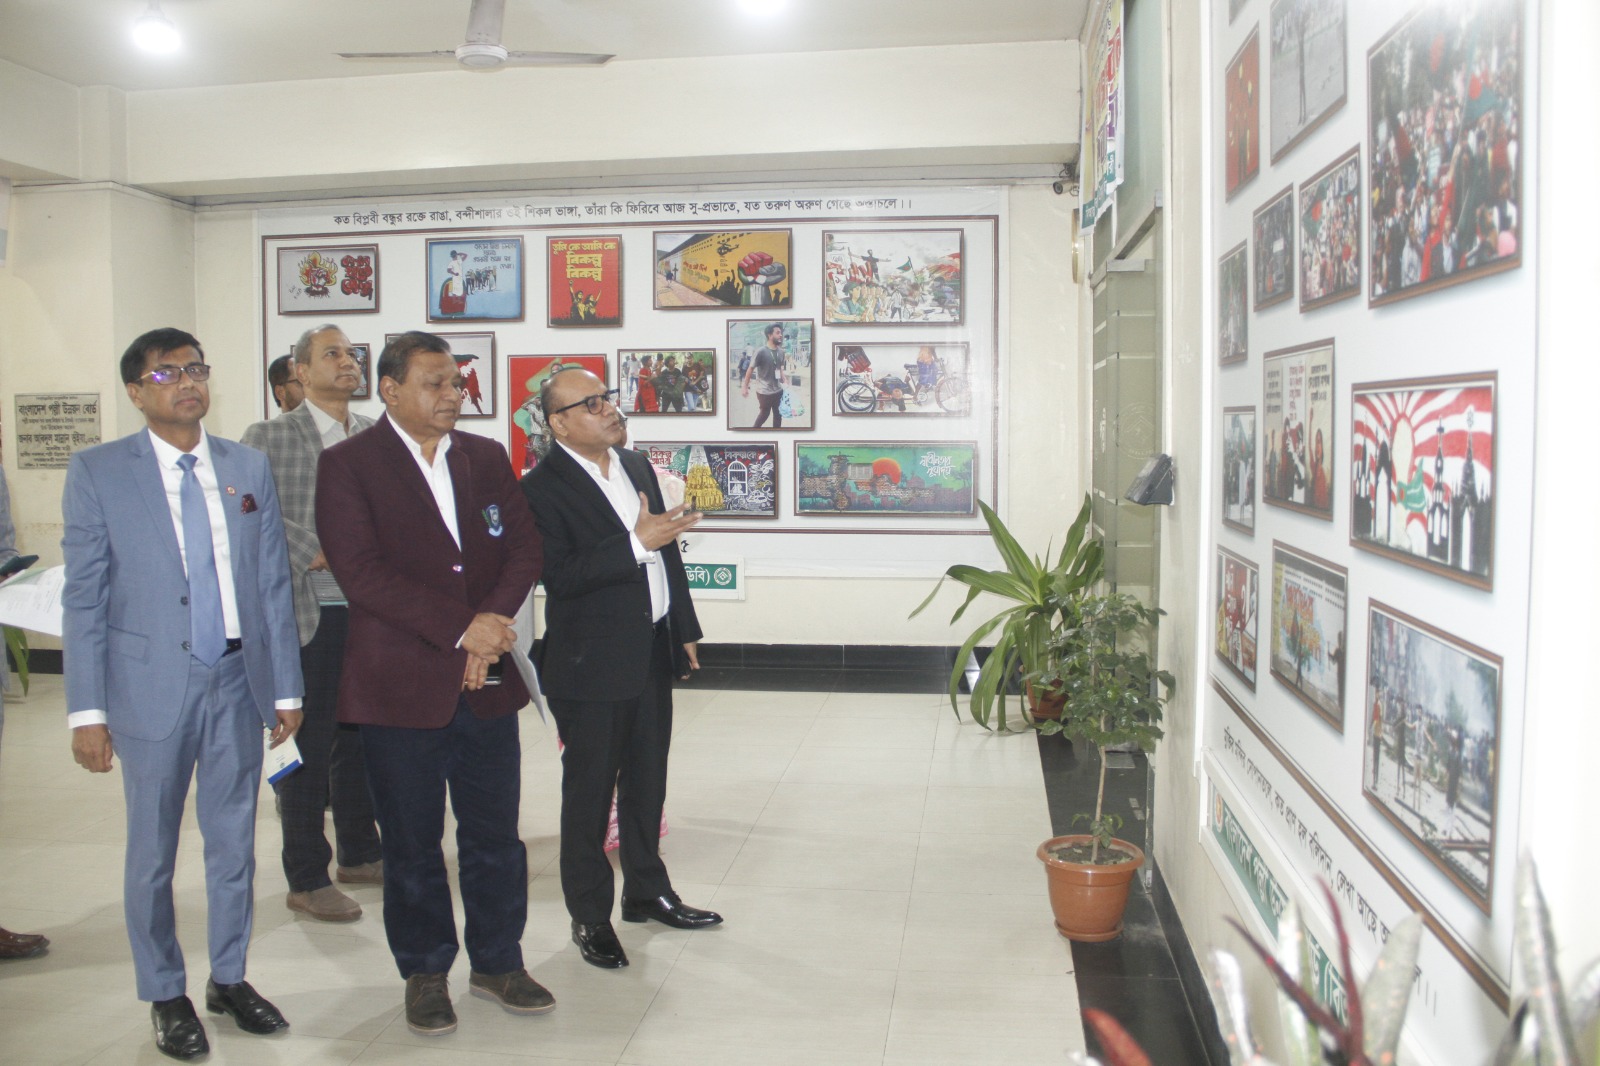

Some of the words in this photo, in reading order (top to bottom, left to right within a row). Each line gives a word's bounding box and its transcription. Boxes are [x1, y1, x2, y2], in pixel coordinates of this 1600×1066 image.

[333, 215, 350, 225] কত
[353, 211, 379, 226] বিপ্লবী
[382, 213, 403, 227] বন্ধুর
[406, 211, 427, 223] রক্তে
[524, 204, 552, 218] শিকল
[584, 202, 606, 216] তাঁরা
[610, 202, 623, 216] কি
[626, 201, 659, 215] ফিরিবে
[662, 202, 685, 214] আজ
[744, 201, 761, 211] যত
[764, 199, 792, 211] তরুণ
[795, 199, 822, 211] অরুণ
[552, 240, 568, 256] তুমি
[568, 243, 580, 251] কে
[581, 240, 603, 252] আমি
[604, 242, 616, 250] কে
[565, 252, 603, 268] বিকল্প
[565, 267, 603, 282] বিকল্প
[18, 404, 46, 416] বাংলাদেশ
[83, 400, 97, 414] বোর্ড
[1357, 892, 1378, 944] আছে
